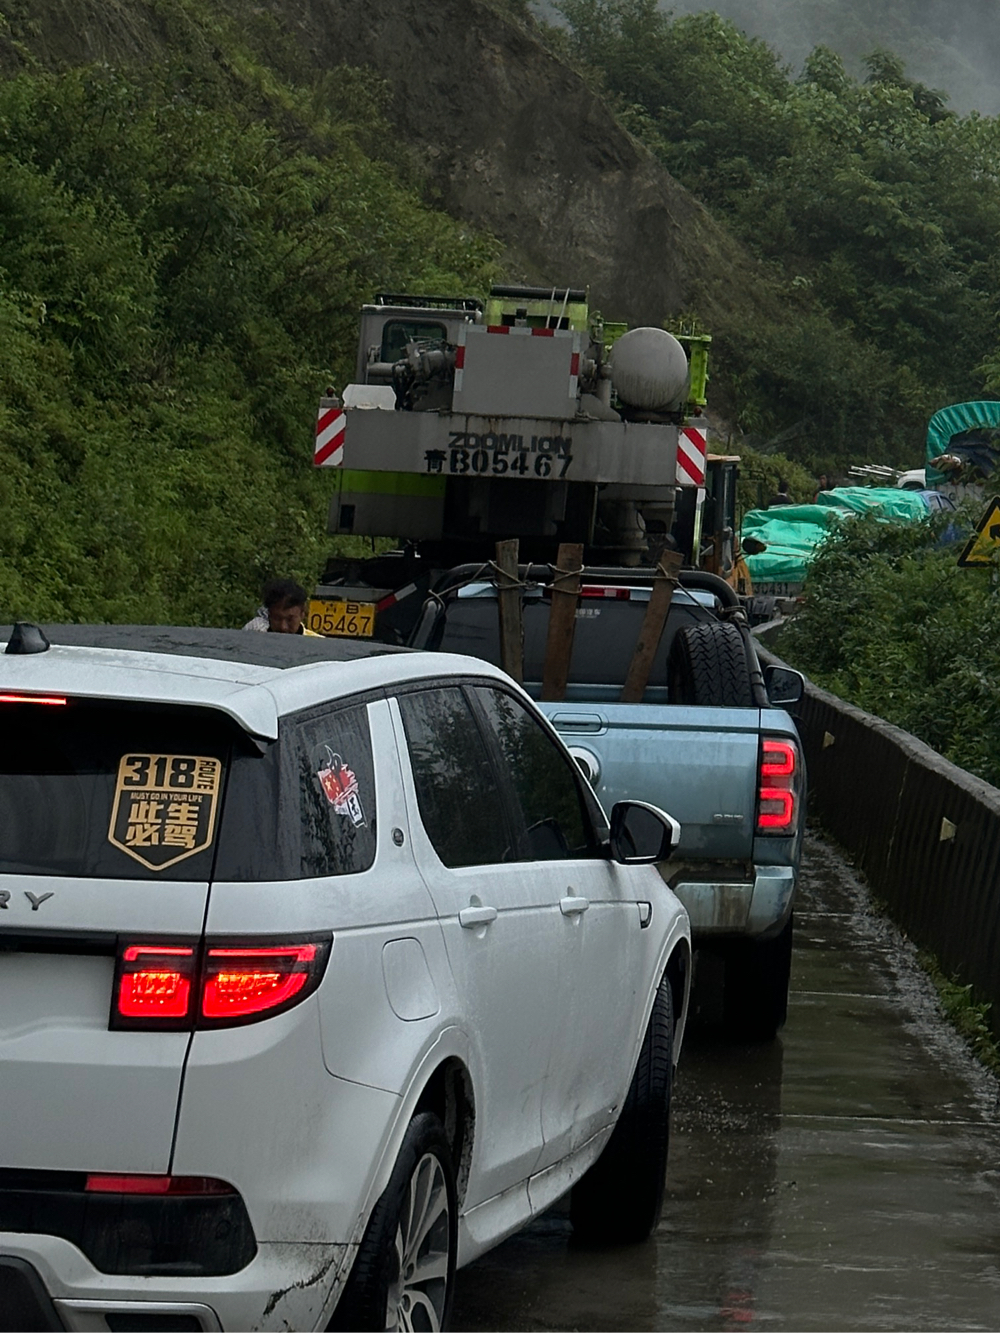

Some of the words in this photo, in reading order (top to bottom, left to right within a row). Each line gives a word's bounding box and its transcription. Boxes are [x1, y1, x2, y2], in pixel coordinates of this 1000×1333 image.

[448, 431, 573, 455] ZOOMLION
[424, 449, 573, 478] 青B05467
[310, 613, 371, 634] 05467
[123, 756, 197, 789] 318
[197, 760, 217, 790] ROUTE
[130, 792, 150, 800] MUST
[150, 792, 160, 801] GO
[160, 793, 169, 801] IN
[169, 793, 188, 802] YOUR
[188, 795, 204, 803] LIFE
[127, 800, 200, 826] 此生
[125, 824, 198, 849] 必驾
